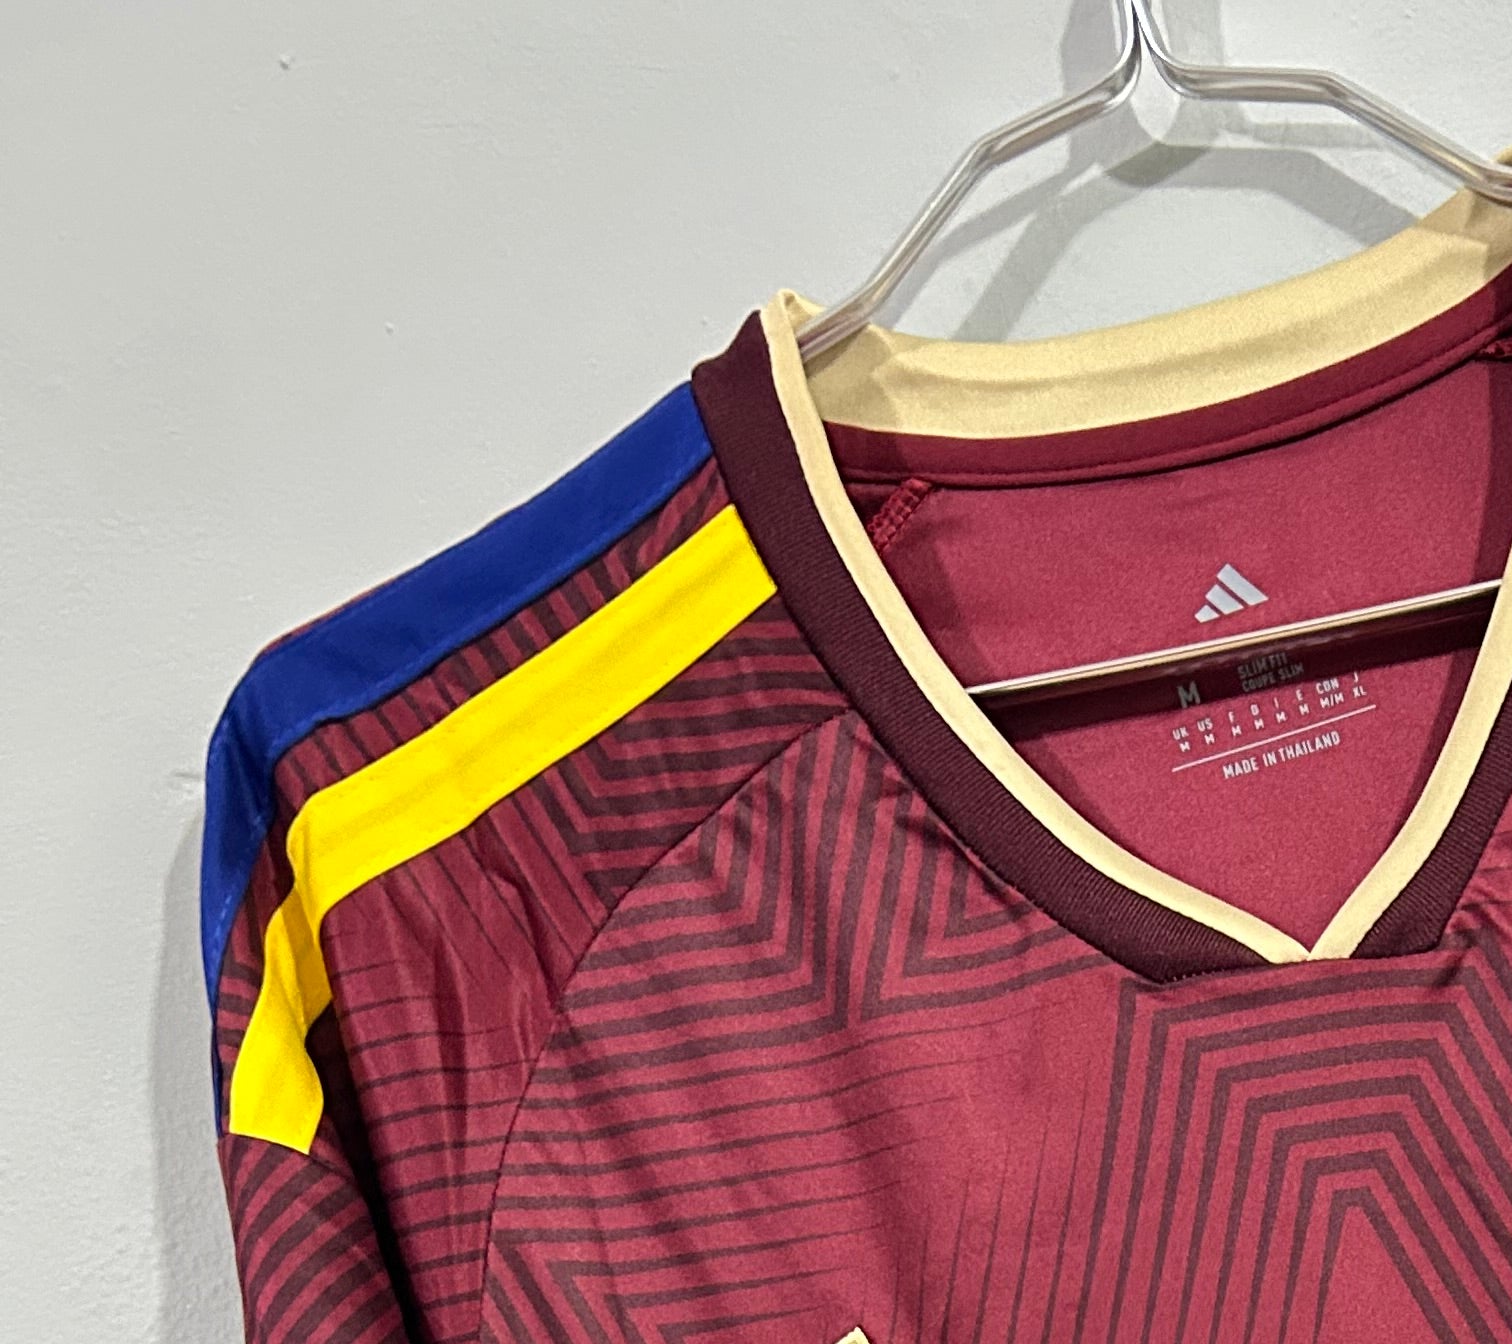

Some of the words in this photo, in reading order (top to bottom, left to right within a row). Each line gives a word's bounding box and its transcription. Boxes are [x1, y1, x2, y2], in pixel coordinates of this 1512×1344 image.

[1177, 681, 1200, 708] M
[1353, 686, 1367, 697] XL
[1173, 727, 1189, 740] UK
[1197, 719, 1213, 732] US
[1228, 712, 1236, 723] F
[1296, 690, 1303, 701] E
[1223, 757, 1259, 779] MADE
[1263, 750, 1278, 766] IN
[1278, 730, 1341, 762] THAILAND
